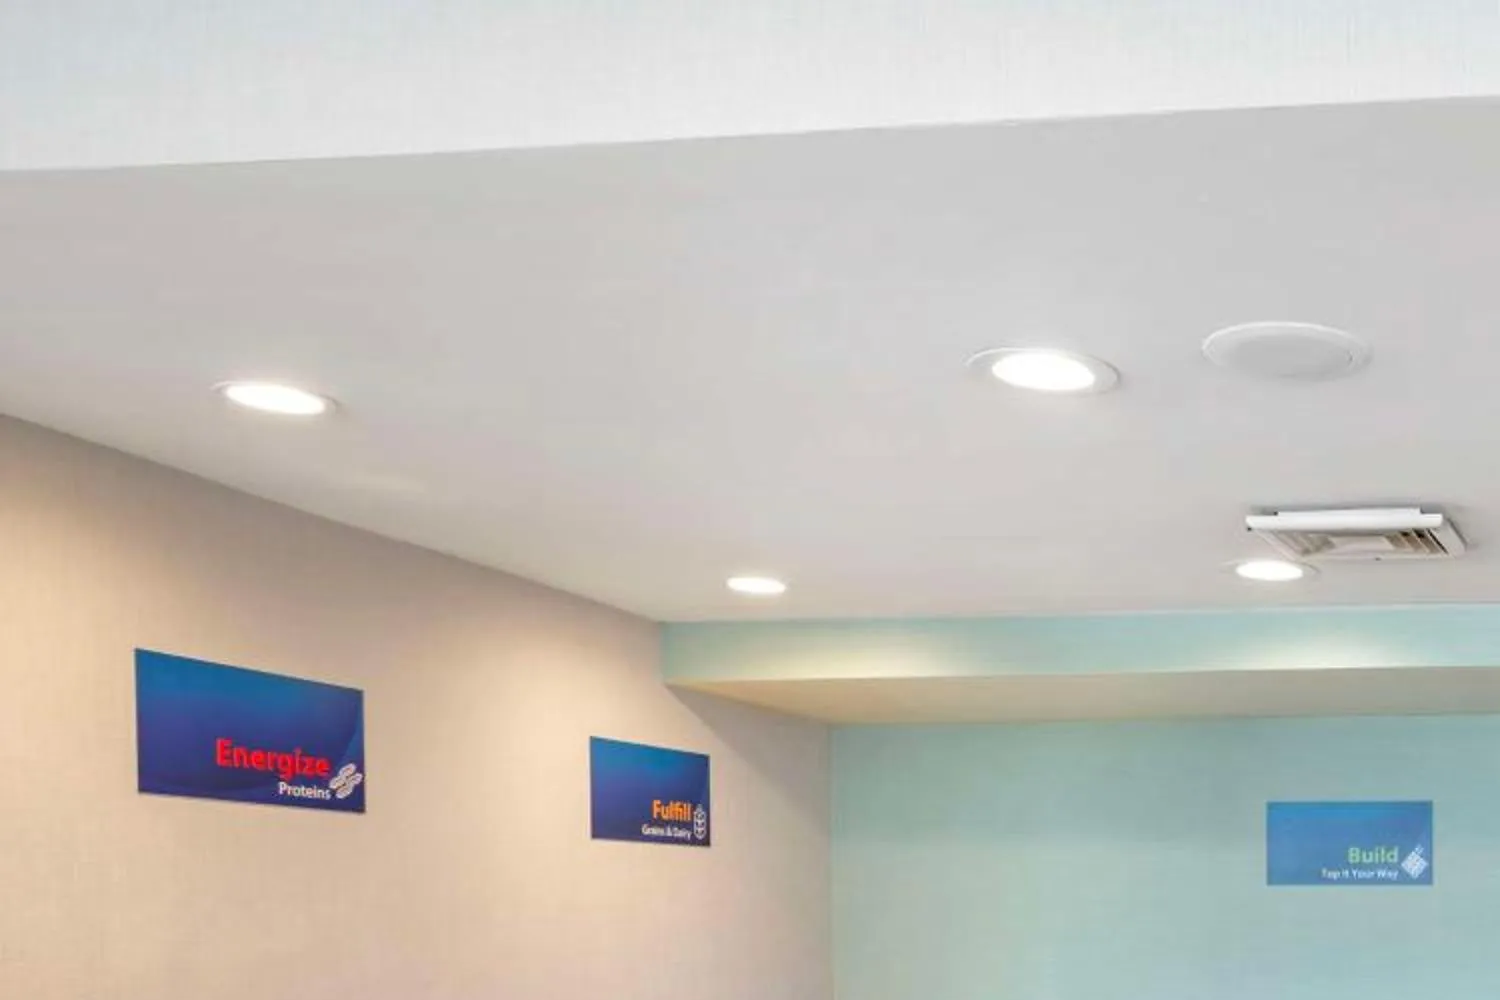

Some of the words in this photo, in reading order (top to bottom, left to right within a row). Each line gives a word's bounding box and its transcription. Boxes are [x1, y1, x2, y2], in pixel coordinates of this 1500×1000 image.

[215, 736, 330, 781] Energize
[278, 781, 332, 800] Proteins
[652, 799, 692, 821] Fulfill
[1347, 846, 1399, 864] Build
